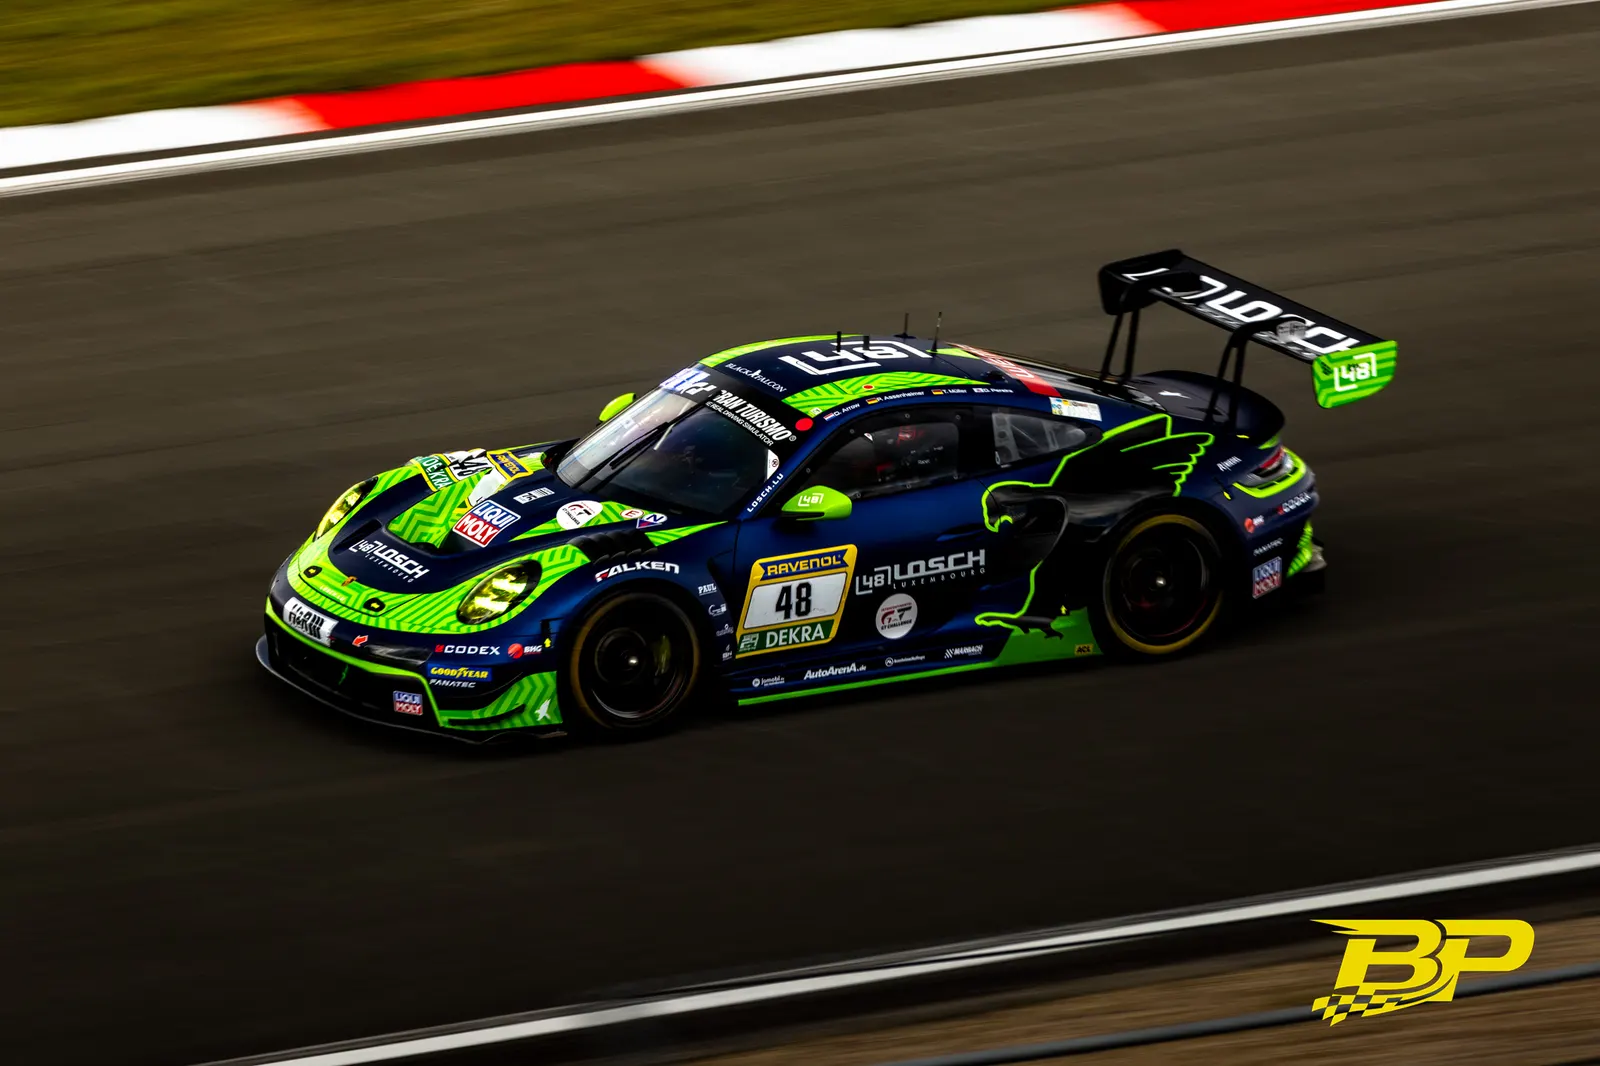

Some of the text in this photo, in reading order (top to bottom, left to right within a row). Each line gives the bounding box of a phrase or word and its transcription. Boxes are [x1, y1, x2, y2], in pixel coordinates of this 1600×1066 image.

[725, 363, 787, 393] BLACK FALCON
[742, 421, 774, 447] SIMULATOR
[746, 473, 784, 513] LOSCH.LU
[472, 502, 517, 527] LIQUI
[456, 514, 499, 543] MOLY
[372, 540, 430, 579] LOSCH
[595, 561, 680, 582] FALKEN
[766, 555, 842, 576] RAVENOL
[894, 549, 986, 580] LOSCH
[698, 583, 717, 594] PAUL
[893, 567, 986, 589] LUXEMBOURG
[774, 582, 812, 620] 48
[765, 623, 825, 648] DEKRA
[443, 644, 501, 656] CODEX
[428, 678, 476, 688] FANATEC
[430, 667, 489, 679] GOODYEAR
